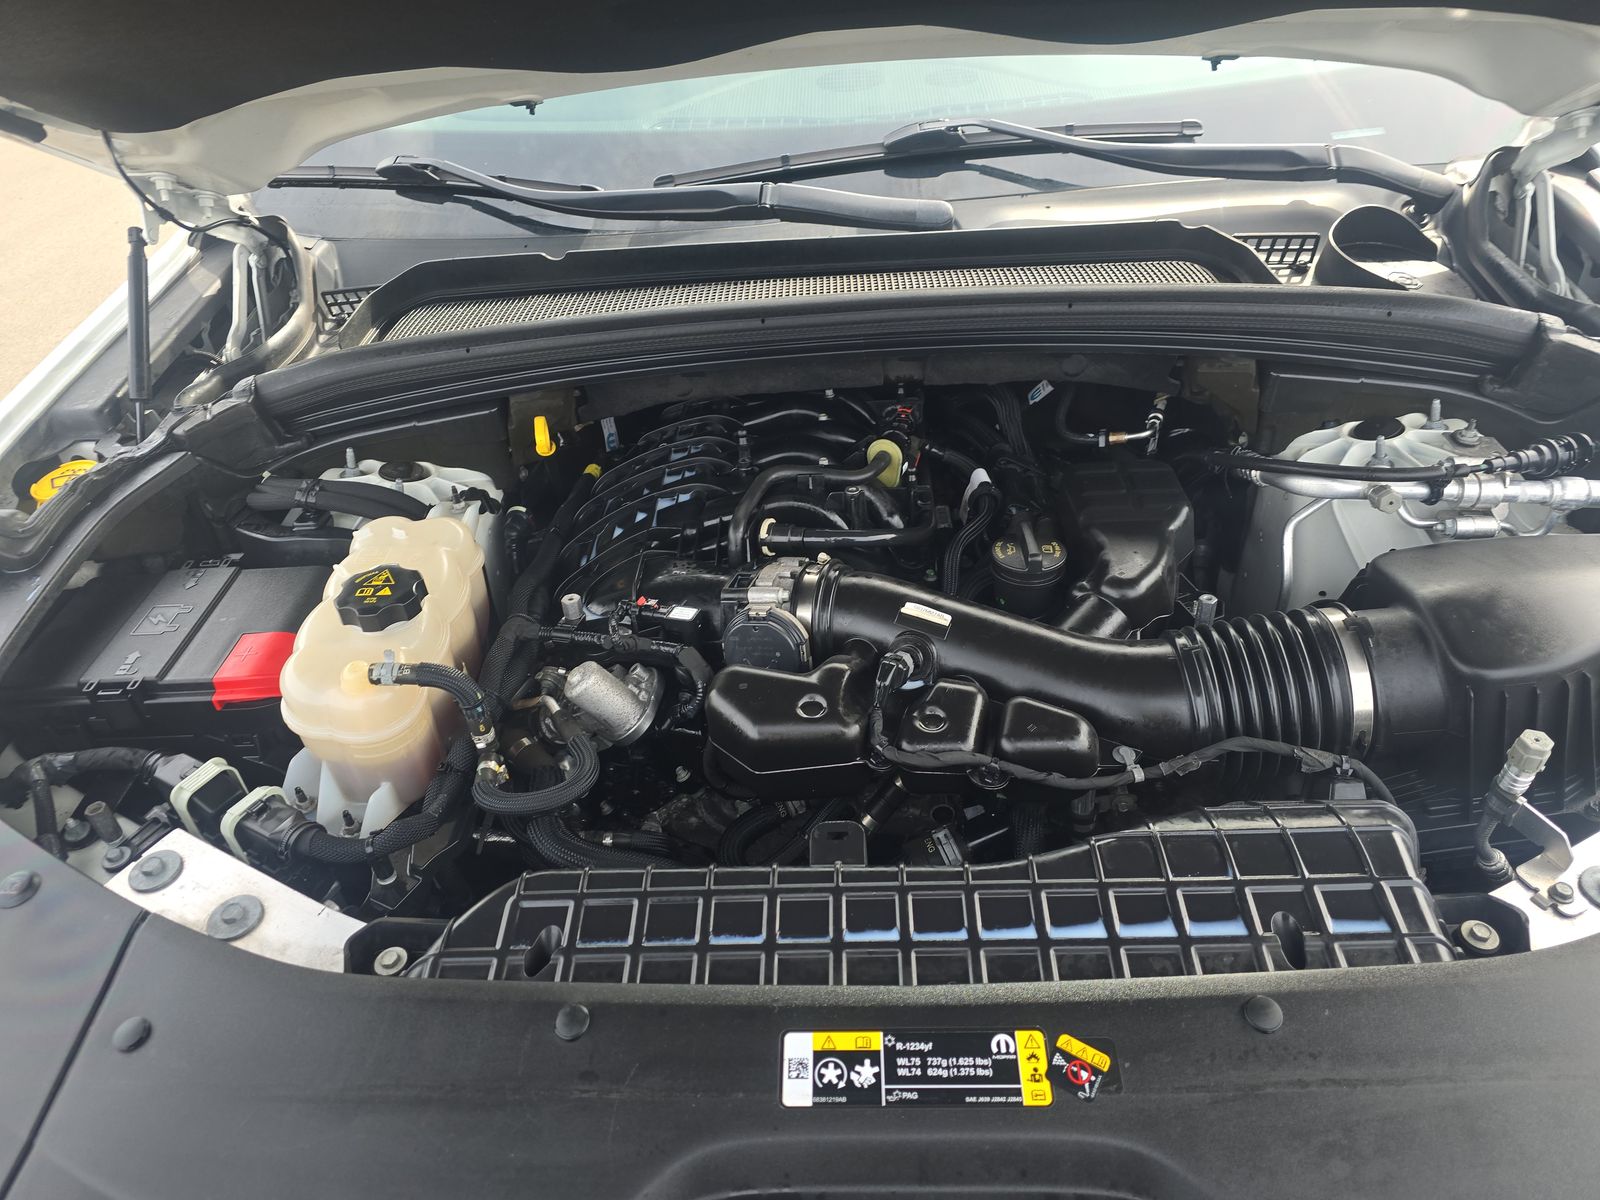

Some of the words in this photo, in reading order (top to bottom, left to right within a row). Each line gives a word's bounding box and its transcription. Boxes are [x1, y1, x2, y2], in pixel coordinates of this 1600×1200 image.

[924, 837, 936, 853] ENG
[895, 1041, 933, 1052] R-1234yf
[896, 1057, 921, 1066] WL75
[926, 1057, 948, 1068] 737g
[948, 1057, 975, 1067] (1.625
[975, 1057, 993, 1067] lbs)
[896, 1067, 922, 1076] WL74
[926, 1067, 949, 1078] 624g
[949, 1067, 976, 1077] (1.375
[976, 1067, 994, 1078] lbs)
[901, 1091, 919, 1099] PAG
